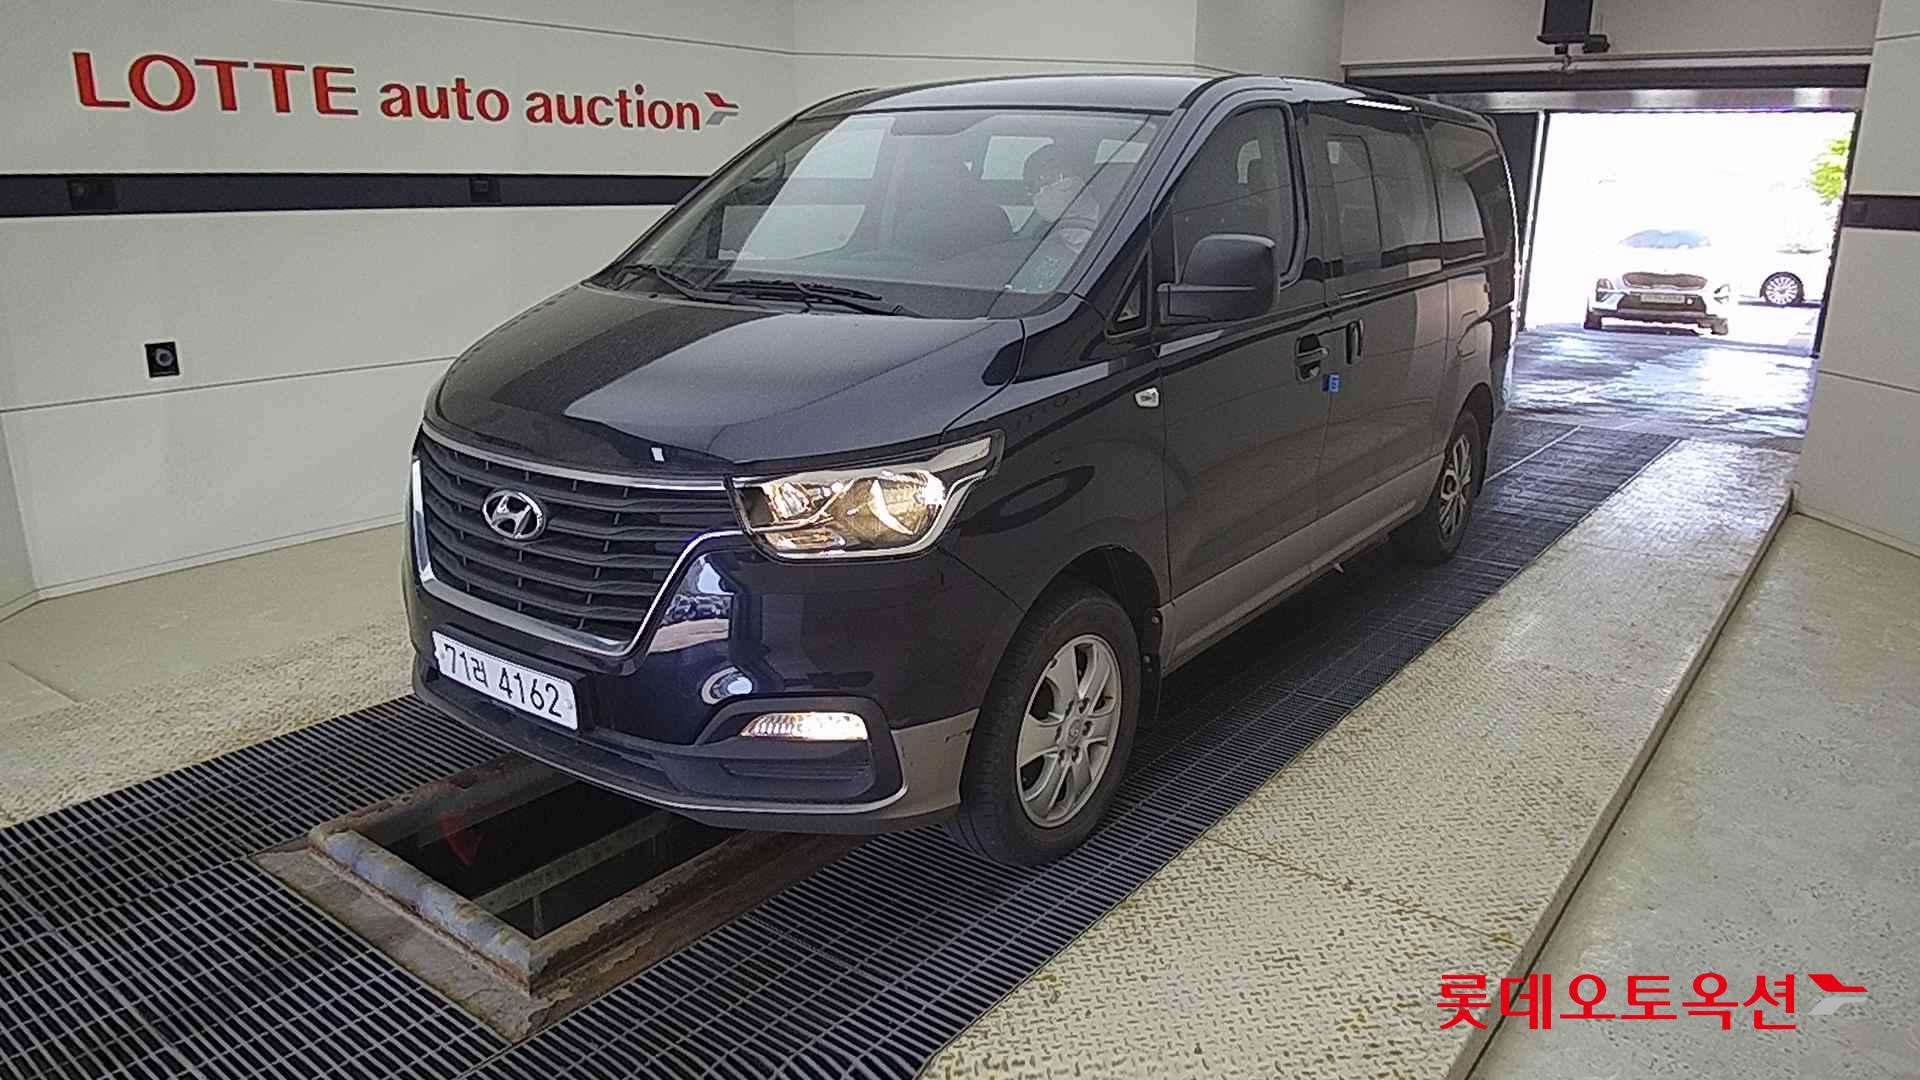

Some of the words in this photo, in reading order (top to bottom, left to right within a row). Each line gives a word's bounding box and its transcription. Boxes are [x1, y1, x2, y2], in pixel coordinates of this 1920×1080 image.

[73, 51, 359, 117] LOTTE
[379, 77, 510, 124] auto
[525, 84, 701, 131] auction
[444, 643, 489, 688] 71러
[499, 667, 562, 718] 4162
